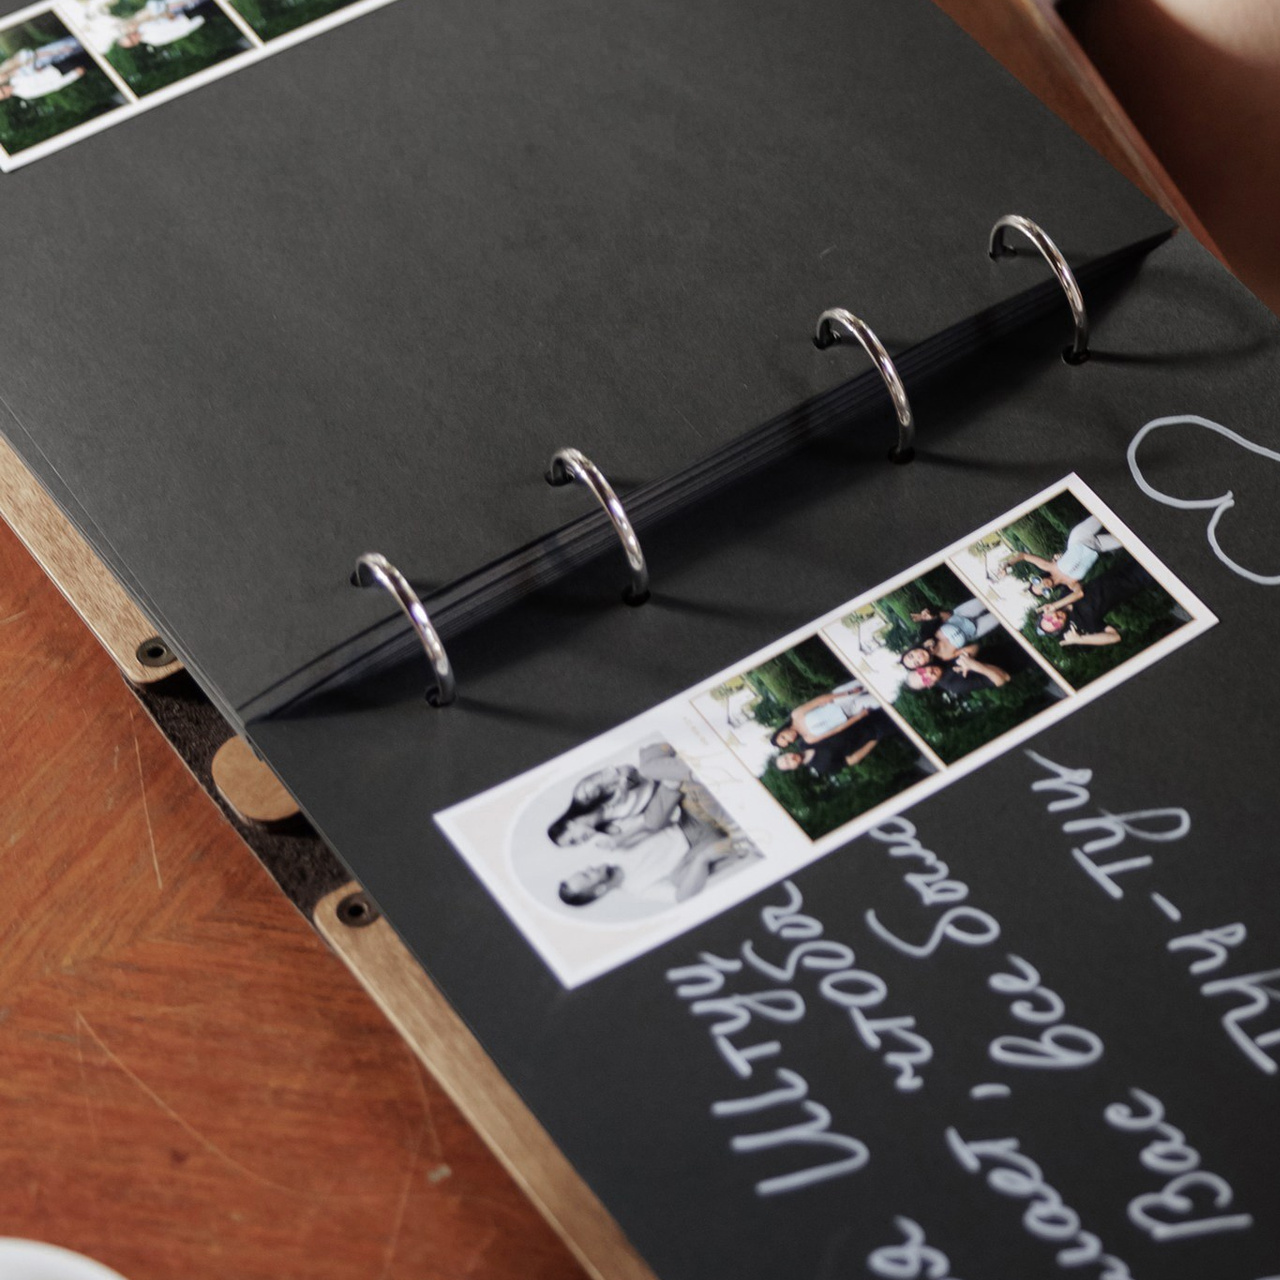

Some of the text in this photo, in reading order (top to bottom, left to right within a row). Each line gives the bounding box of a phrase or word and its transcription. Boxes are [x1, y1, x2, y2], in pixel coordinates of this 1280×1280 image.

[863, 814, 1003, 960] было
[739, 877, 935, 1093] чтобы
[986, 953, 1106, 1070] все
[1102, 1087, 1252, 1242] Вас
